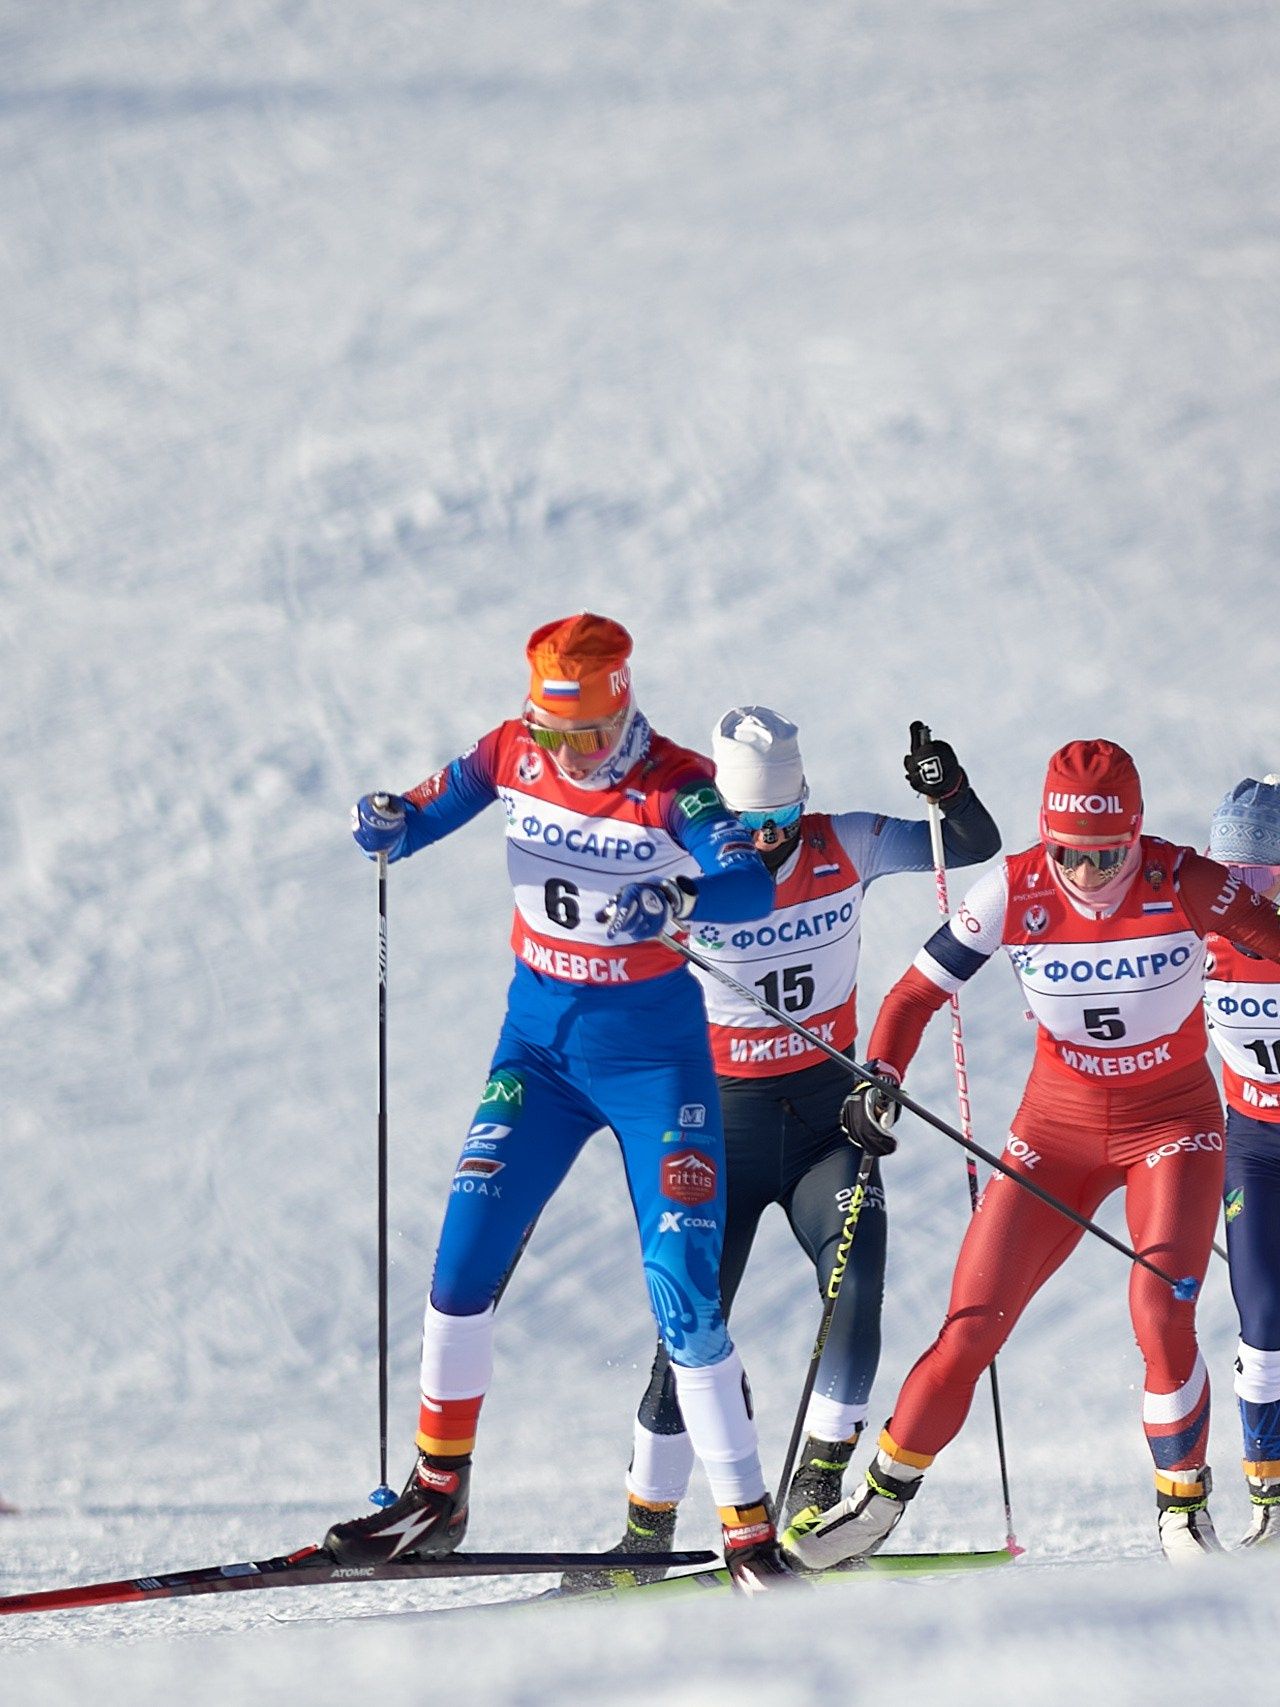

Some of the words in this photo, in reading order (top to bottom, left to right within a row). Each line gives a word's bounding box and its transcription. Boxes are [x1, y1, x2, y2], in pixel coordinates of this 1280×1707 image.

[1048, 791, 1124, 814] LUKOIL
[522, 815, 657, 862] ФОСАГРО
[544, 877, 581, 930] 6
[731, 902, 853, 950] ФОСАГРО
[1043, 945, 1190, 984] ФОСАГРО
[754, 963, 816, 1016] 15
[730, 1020, 835, 1063] ИЖЕВСК
[1083, 1007, 1126, 1041] 5
[1061, 1042, 1172, 1077] ИЖЕВСК
[1145, 1132, 1223, 1169] BOSCO
[668, 1171, 713, 1188] rittis
[682, 1218, 718, 1230] COXA
[331, 1567, 375, 1578] ATOMIC
